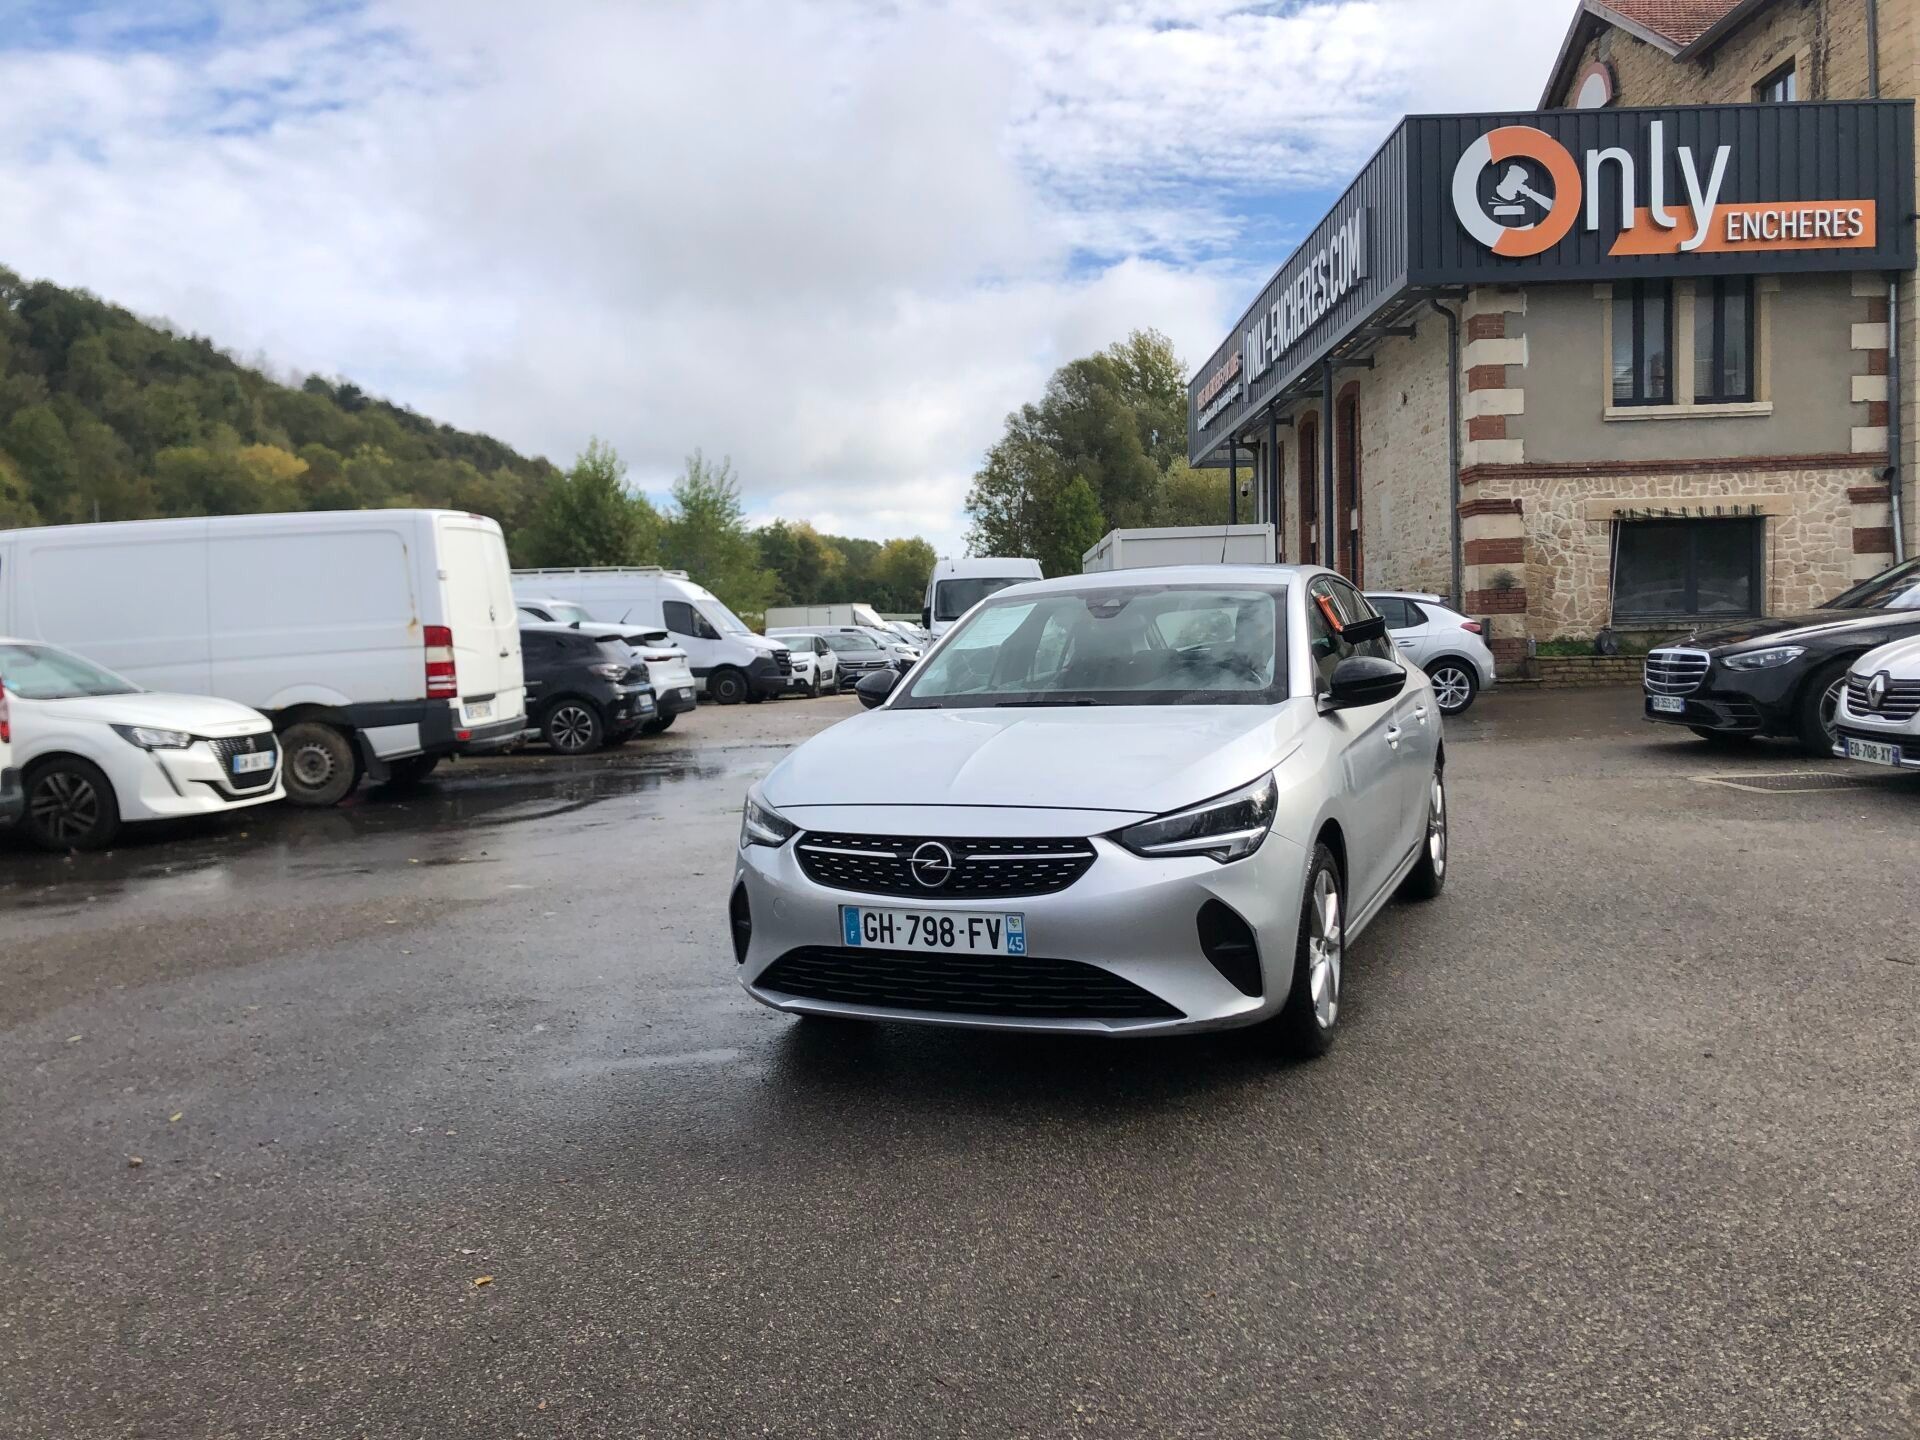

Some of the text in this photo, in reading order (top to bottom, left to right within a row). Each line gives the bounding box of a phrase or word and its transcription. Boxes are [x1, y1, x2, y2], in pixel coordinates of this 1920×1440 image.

[1452, 121, 1731, 257] Only
[1726, 208, 1864, 242] ENCHERES
[1246, 207, 1364, 385] ONLY-ENCHERES.COM
[850, 912, 1024, 951] F GH-798-FV 45
